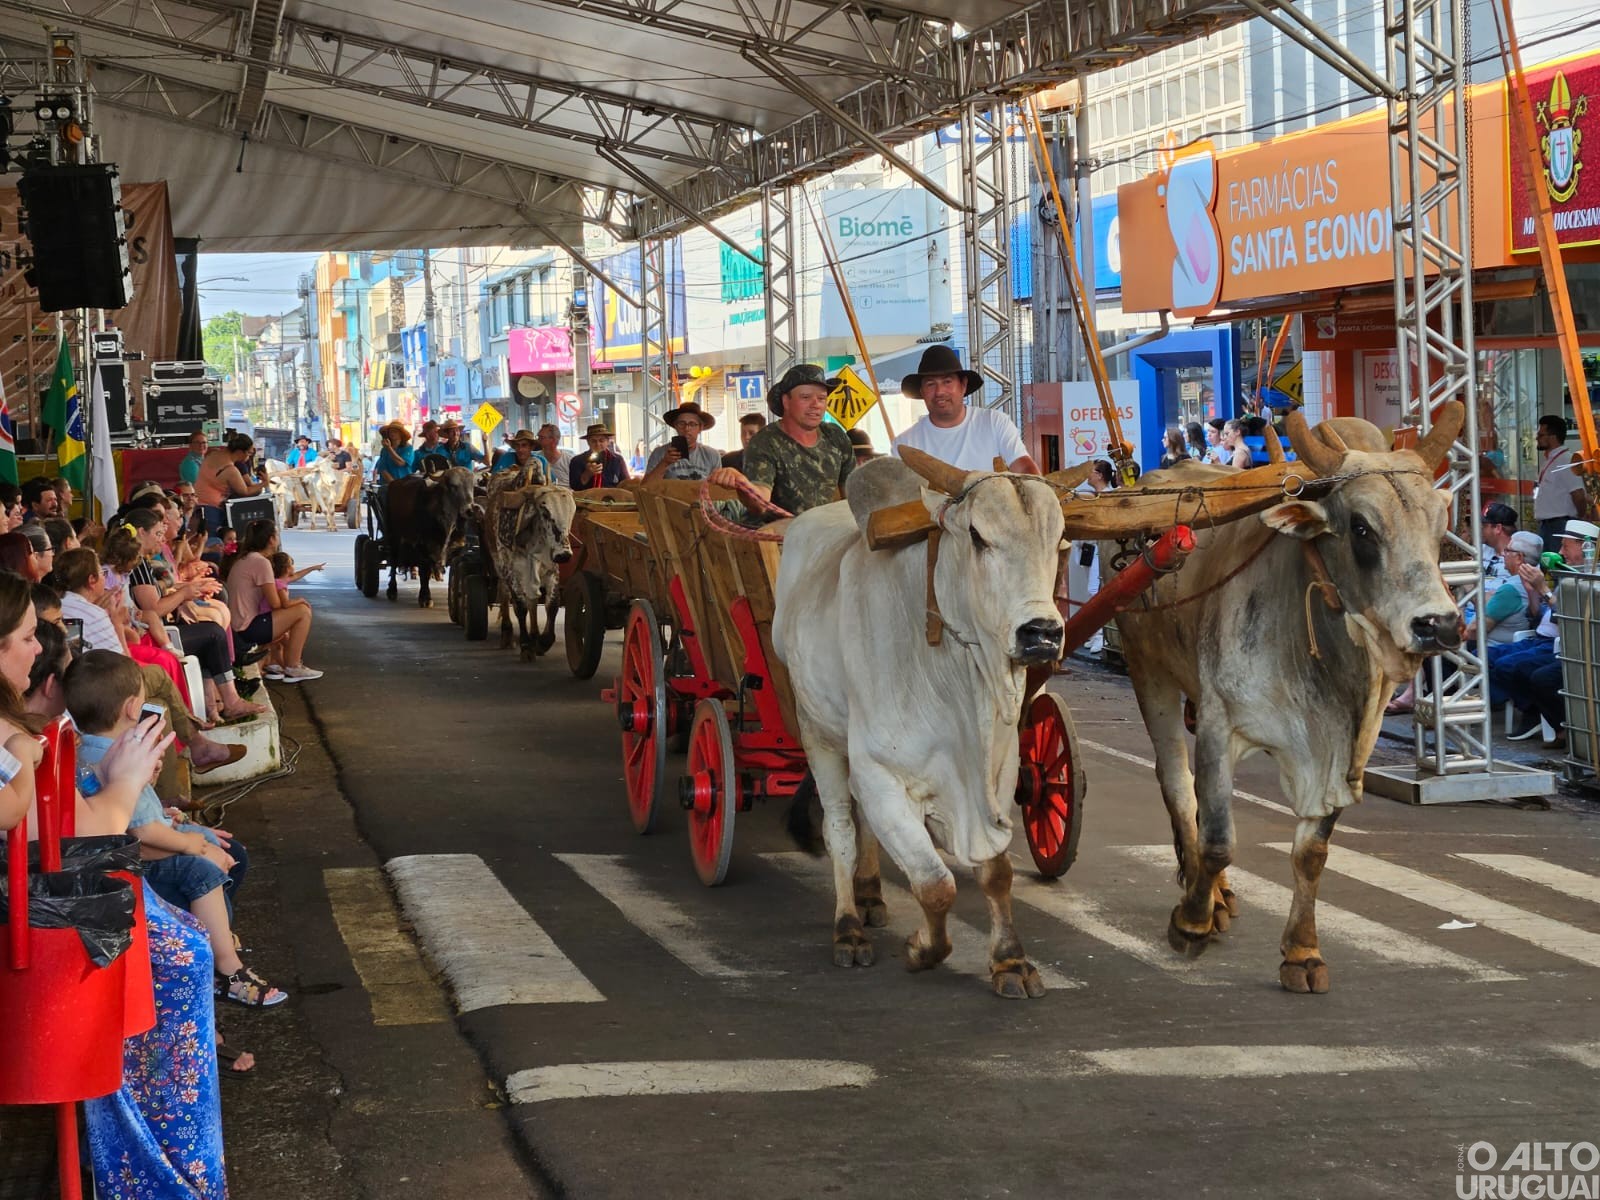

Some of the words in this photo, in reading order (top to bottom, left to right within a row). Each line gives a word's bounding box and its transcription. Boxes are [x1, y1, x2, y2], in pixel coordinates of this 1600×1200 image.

[1229, 158, 1339, 223] FARMÁCIAS
[839, 215, 914, 238] Biomē
[1231, 226, 1297, 275] SANTA
[1305, 203, 1432, 264] ECONO
[157, 404, 208, 416] PLS
[1070, 406, 1134, 422] OFEAS
